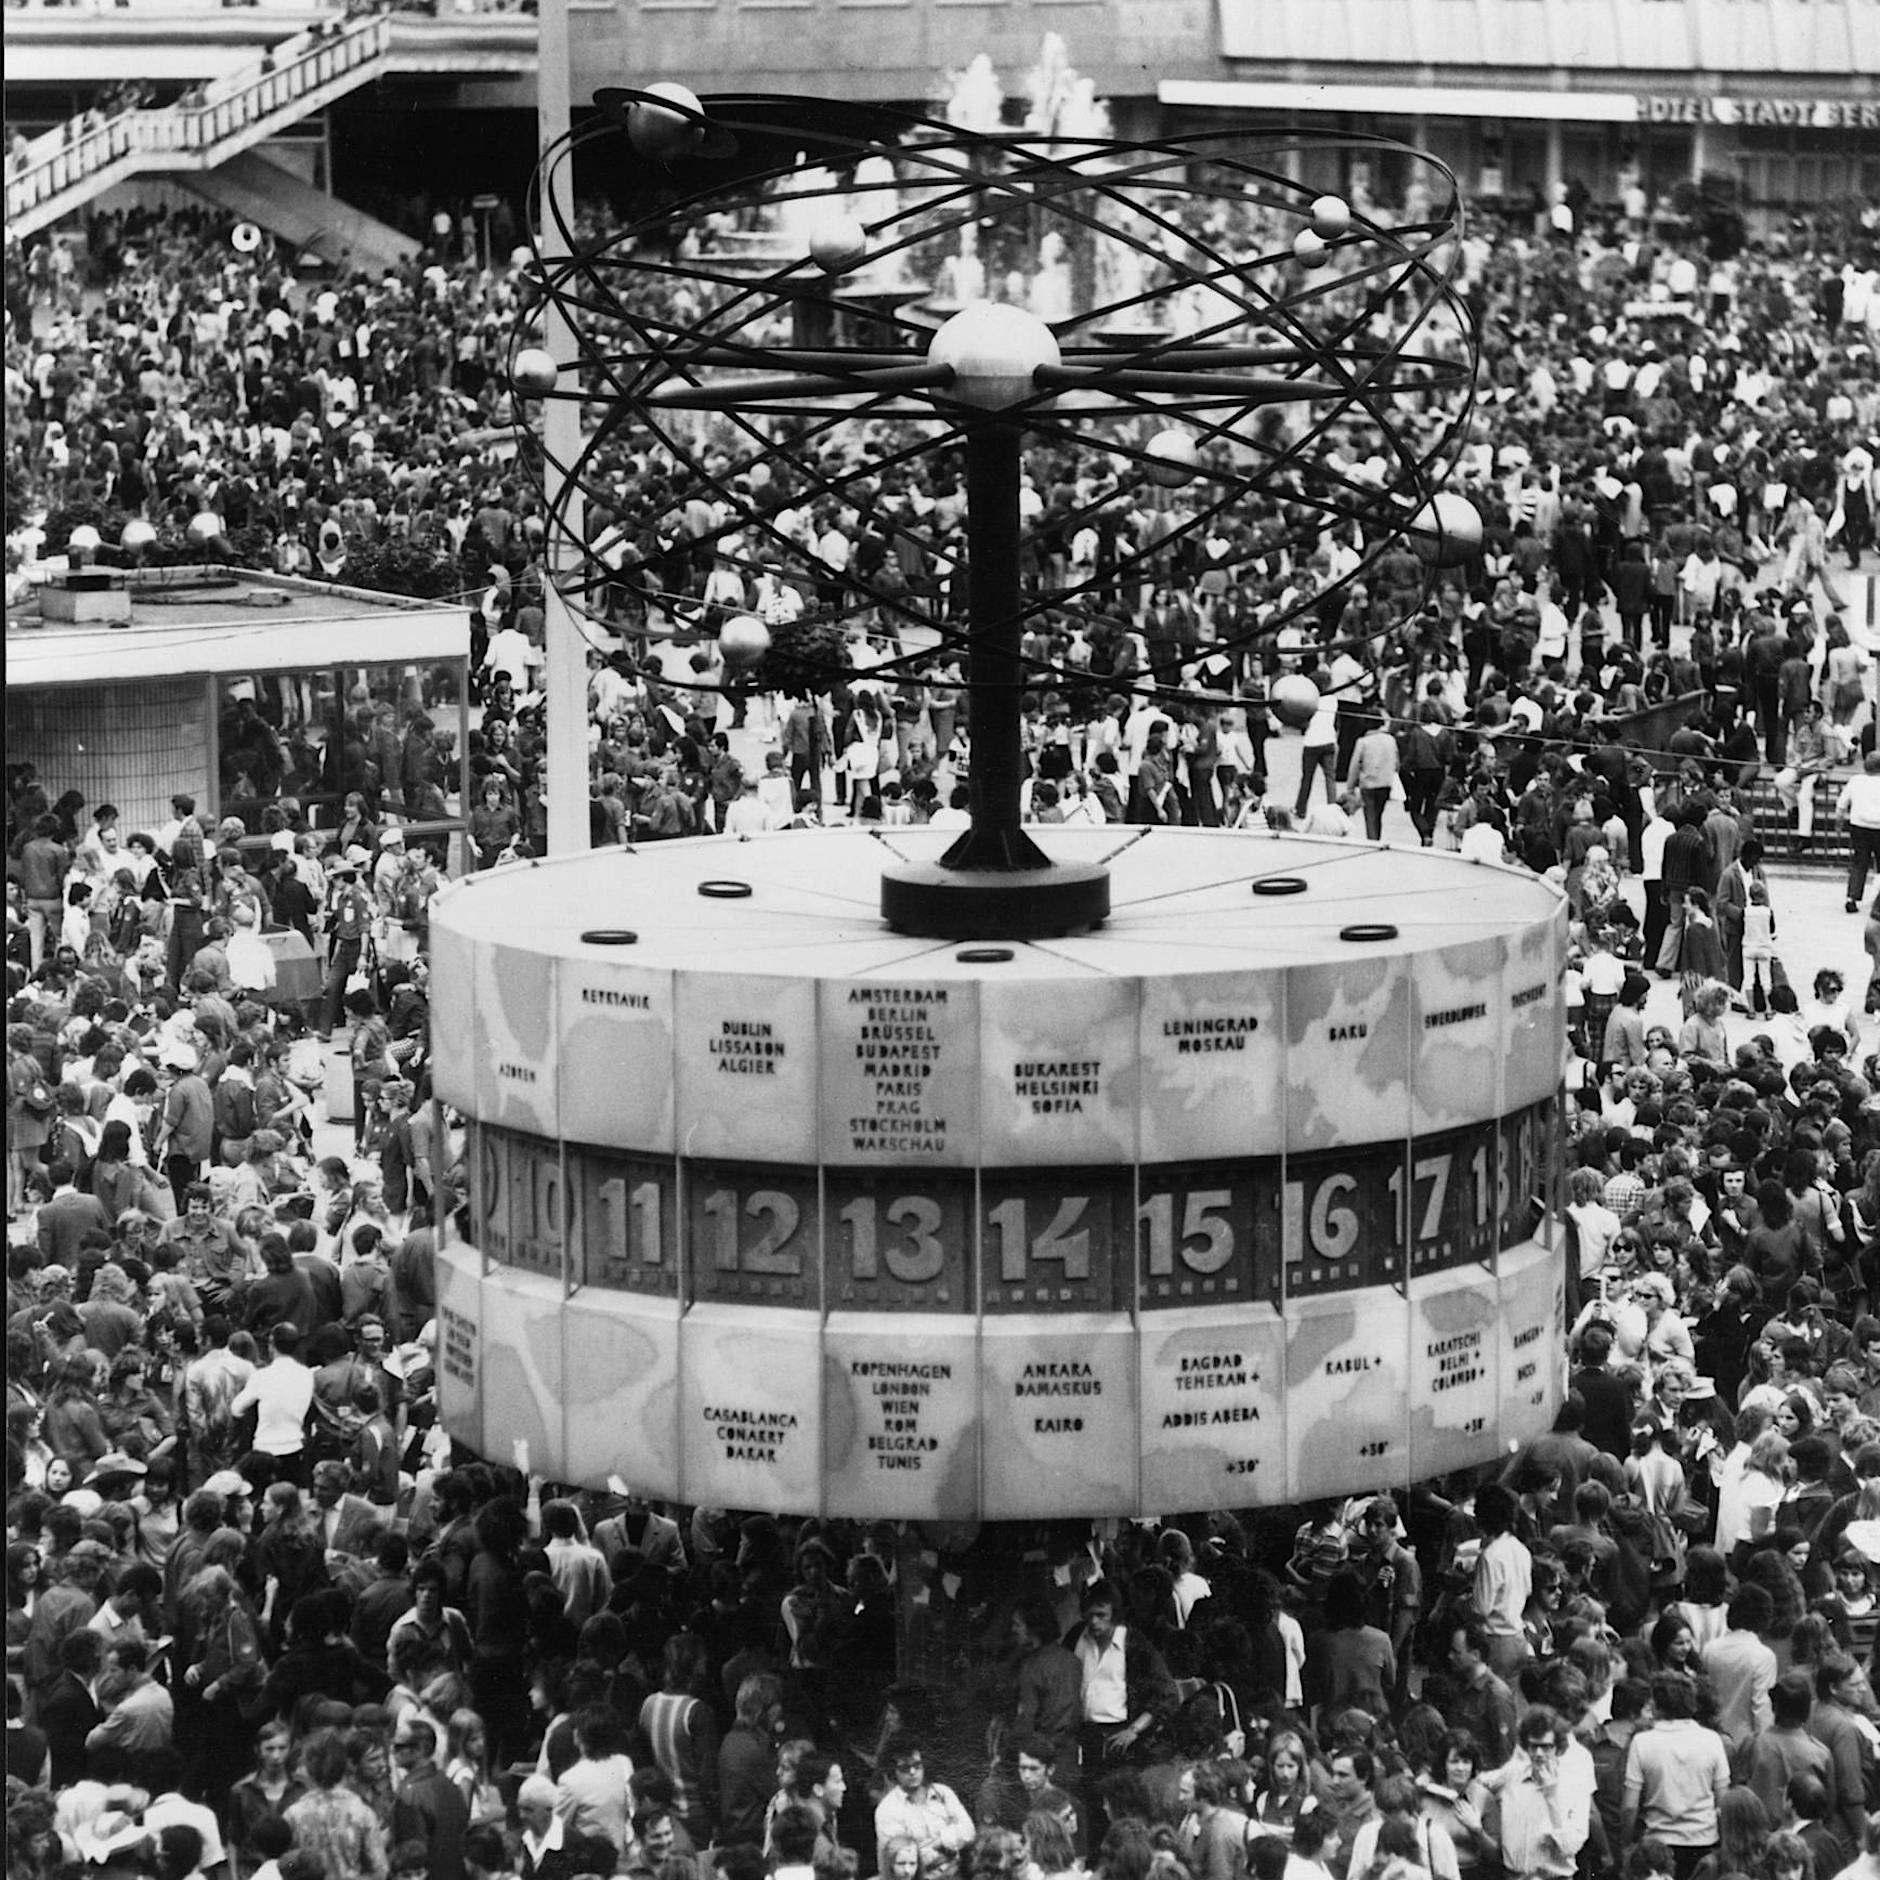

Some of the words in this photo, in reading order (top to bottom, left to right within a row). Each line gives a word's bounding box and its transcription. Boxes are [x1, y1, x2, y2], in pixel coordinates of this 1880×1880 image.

[1730, 99, 1814, 124] STADT
[850, 989, 947, 1003] AMSTERDAM
[869, 1008, 926, 1022] BERLIN
[723, 1022, 771, 1036] DUBLIN
[862, 1026, 934, 1040] BRÜSSEL
[1164, 1017, 1258, 1035] LENINGRAD
[1330, 1025, 1366, 1041] BAKU
[710, 1040, 784, 1056] LISSABON
[857, 1045, 940, 1059] BUDAPEST
[1179, 1037, 1244, 1052] MOSKAU
[719, 1059, 774, 1074] ALGIER
[865, 1064, 930, 1077] MADRID
[1015, 1062, 1100, 1077] BUKAREST
[877, 1082, 920, 1096] PARIS
[1017, 1080, 1098, 1095] HELSINKI
[877, 1101, 920, 1114] PRAG
[1033, 1100, 1082, 1113] SOFIA
[850, 1119, 946, 1133] STOCKHOLM
[853, 1138, 944, 1151] WARSCHAU
[1388, 1154, 1451, 1245] 17
[599, 1179, 661, 1263] 11
[1274, 1173, 1359, 1262] 16
[704, 1189, 801, 1275] 12
[841, 1196, 944, 1282] 13
[989, 1197, 1090, 1280] 14
[1139, 1190, 1234, 1277] 15
[852, 1362, 950, 1378] KOPENHAGEN
[1024, 1363, 1092, 1377] ANKARA
[1182, 1354, 1242, 1371] BAGDAD
[1326, 1359, 1369, 1374] KABUL
[1440, 1354, 1469, 1372] DELHI
[1176, 1372, 1246, 1389] TEHERAN
[1433, 1367, 1476, 1392] COLOMBO
[873, 1382, 929, 1395] LONDON
[1016, 1381, 1101, 1396] DAMASKUS
[882, 1401, 918, 1413] WIEN
[703, 1408, 797, 1428] CASABLANCA
[1035, 1418, 1083, 1432] KAIRO
[1163, 1412, 1206, 1428] ADDIS
[1212, 1408, 1259, 1424] ABEBA
[885, 1420, 916, 1432] ROM
[718, 1427, 784, 1443] CONAKRY
[869, 1437, 937, 1450] BELGRAD
[727, 1446, 775, 1462] DAKAR
[878, 1455, 921, 1469] TUNIS
